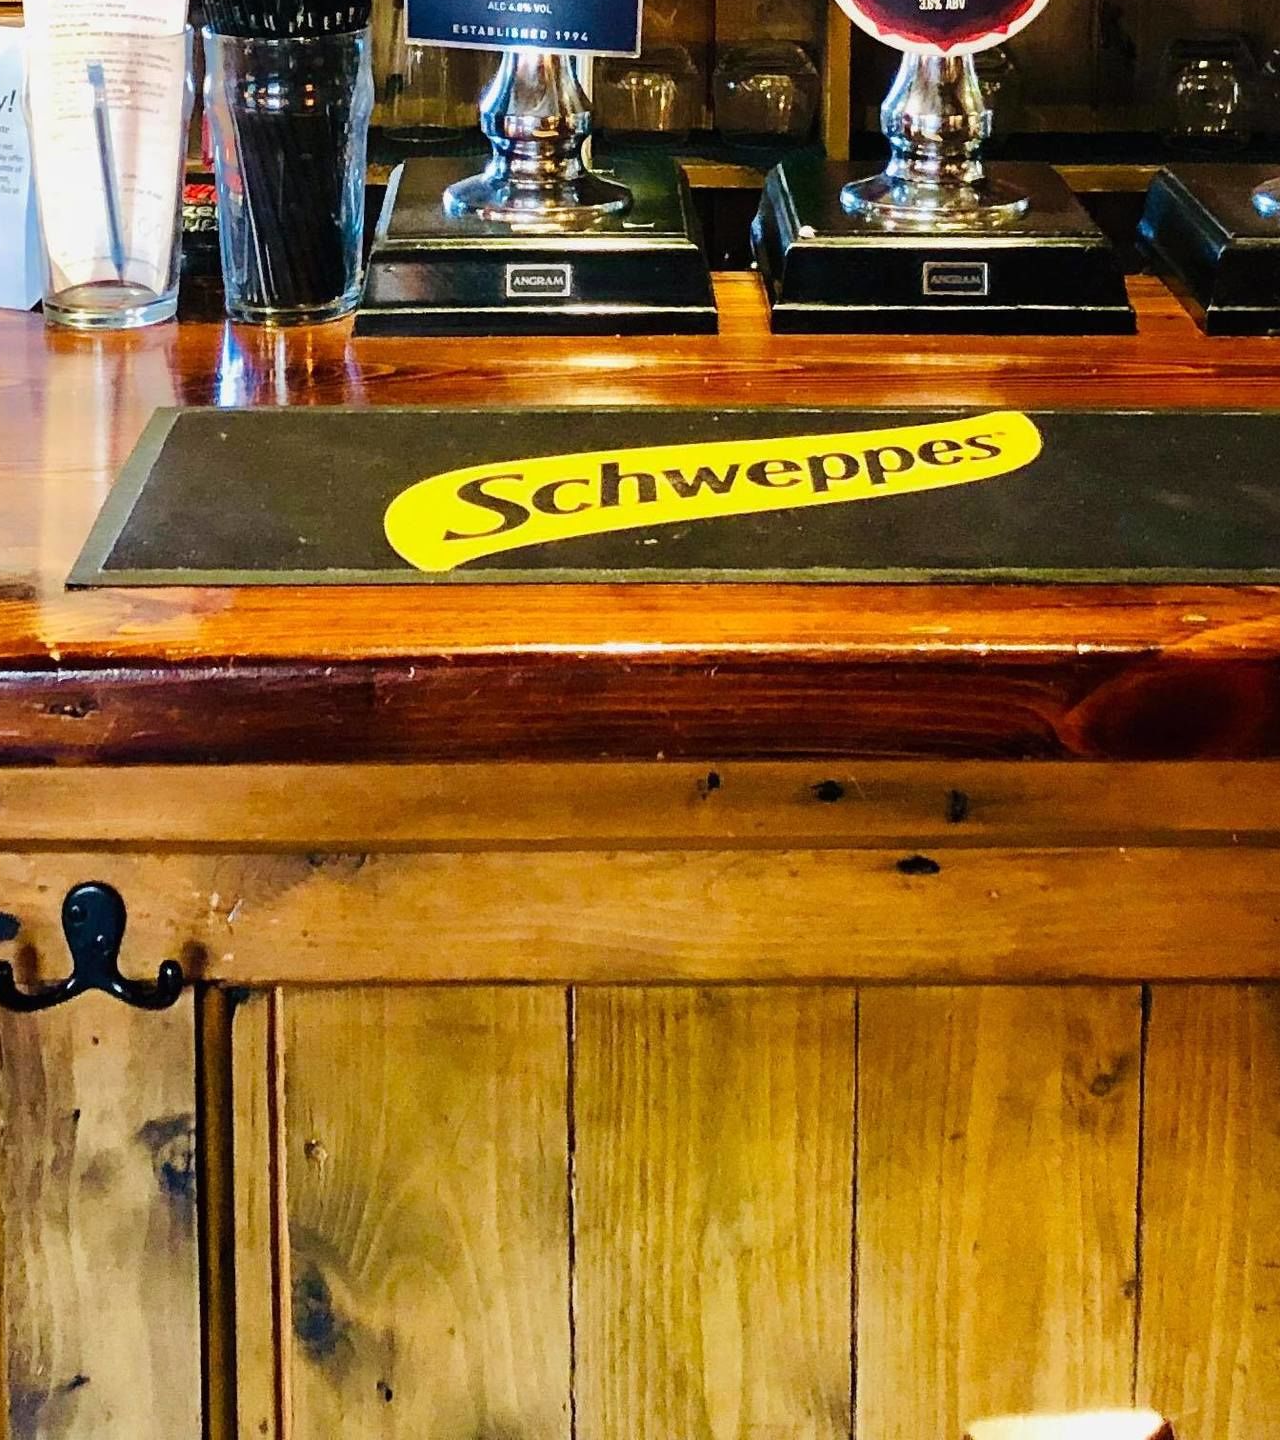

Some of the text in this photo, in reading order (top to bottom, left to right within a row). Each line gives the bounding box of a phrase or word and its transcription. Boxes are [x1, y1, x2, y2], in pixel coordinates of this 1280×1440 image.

[487, 1, 553, 14] ALC VOL
[452, 24, 589, 42] ESTABLISHED 1994
[513, 274, 564, 287] ANGRAM
[443, 432, 1000, 542] Schweppes
